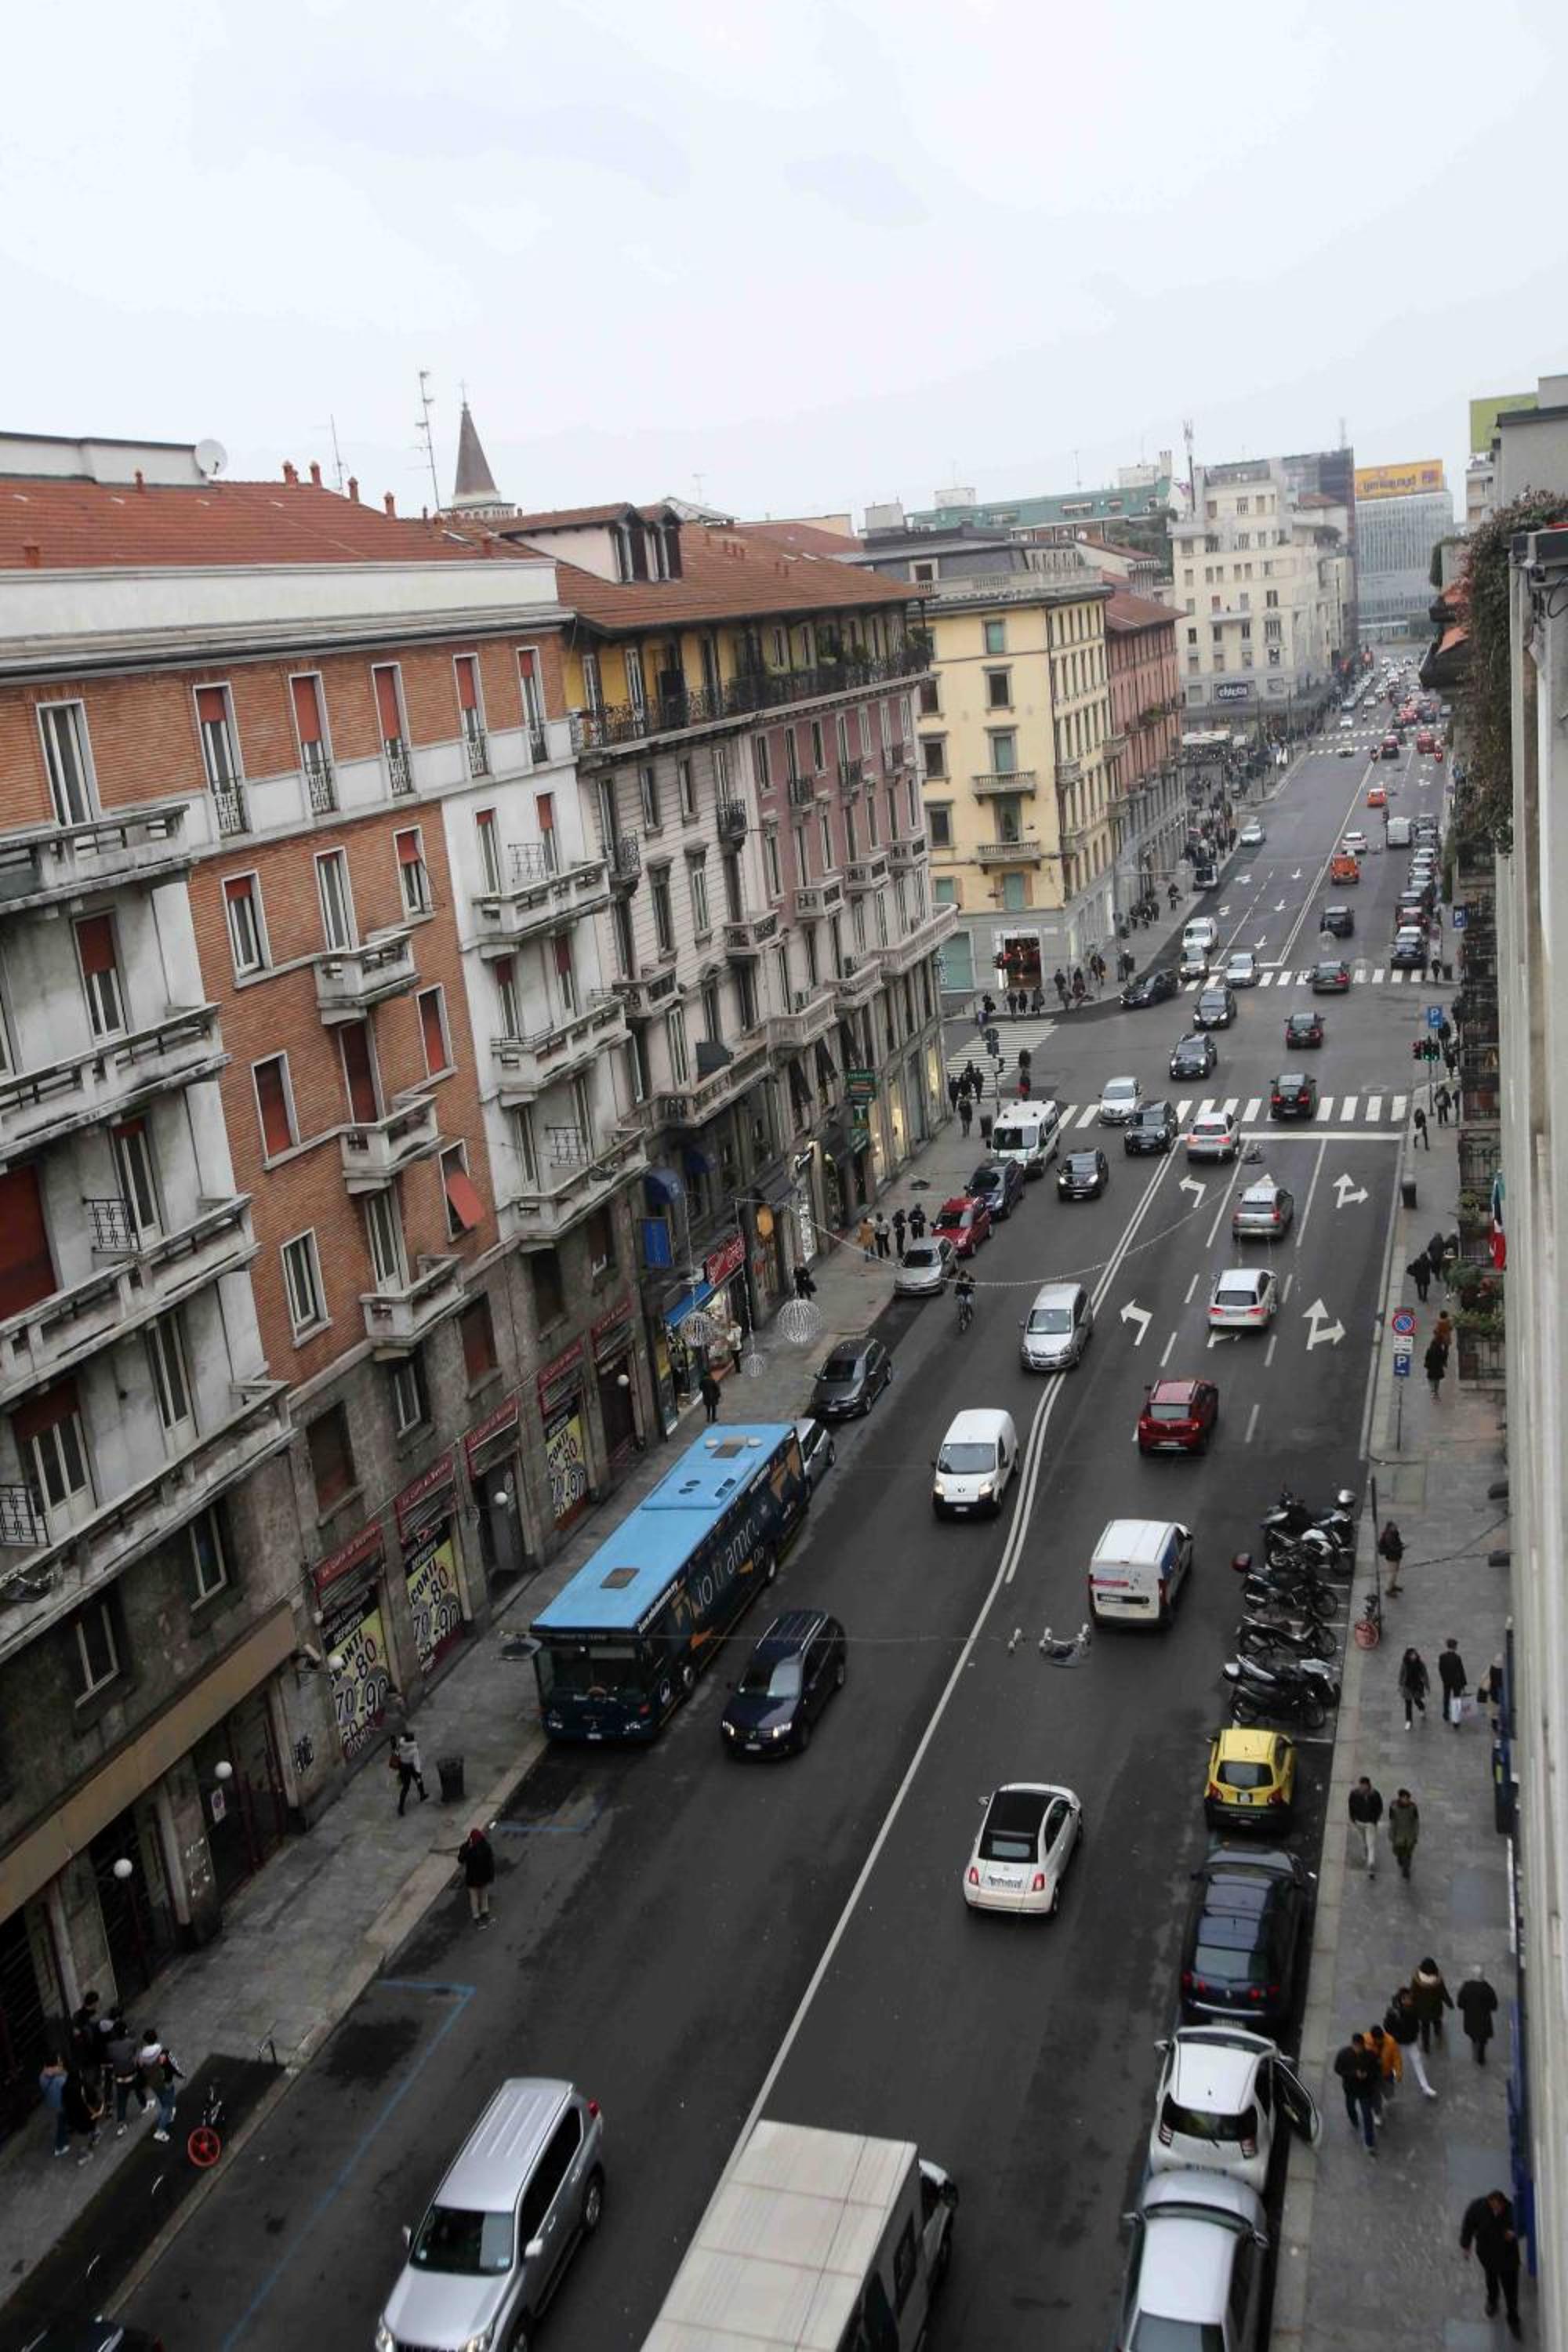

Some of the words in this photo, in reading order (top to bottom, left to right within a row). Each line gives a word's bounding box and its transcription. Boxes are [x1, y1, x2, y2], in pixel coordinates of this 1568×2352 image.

[1430, 1007, 1439, 1019] P
[854, 1104, 866, 1120] T
[1396, 1356, 1407, 1367] P
